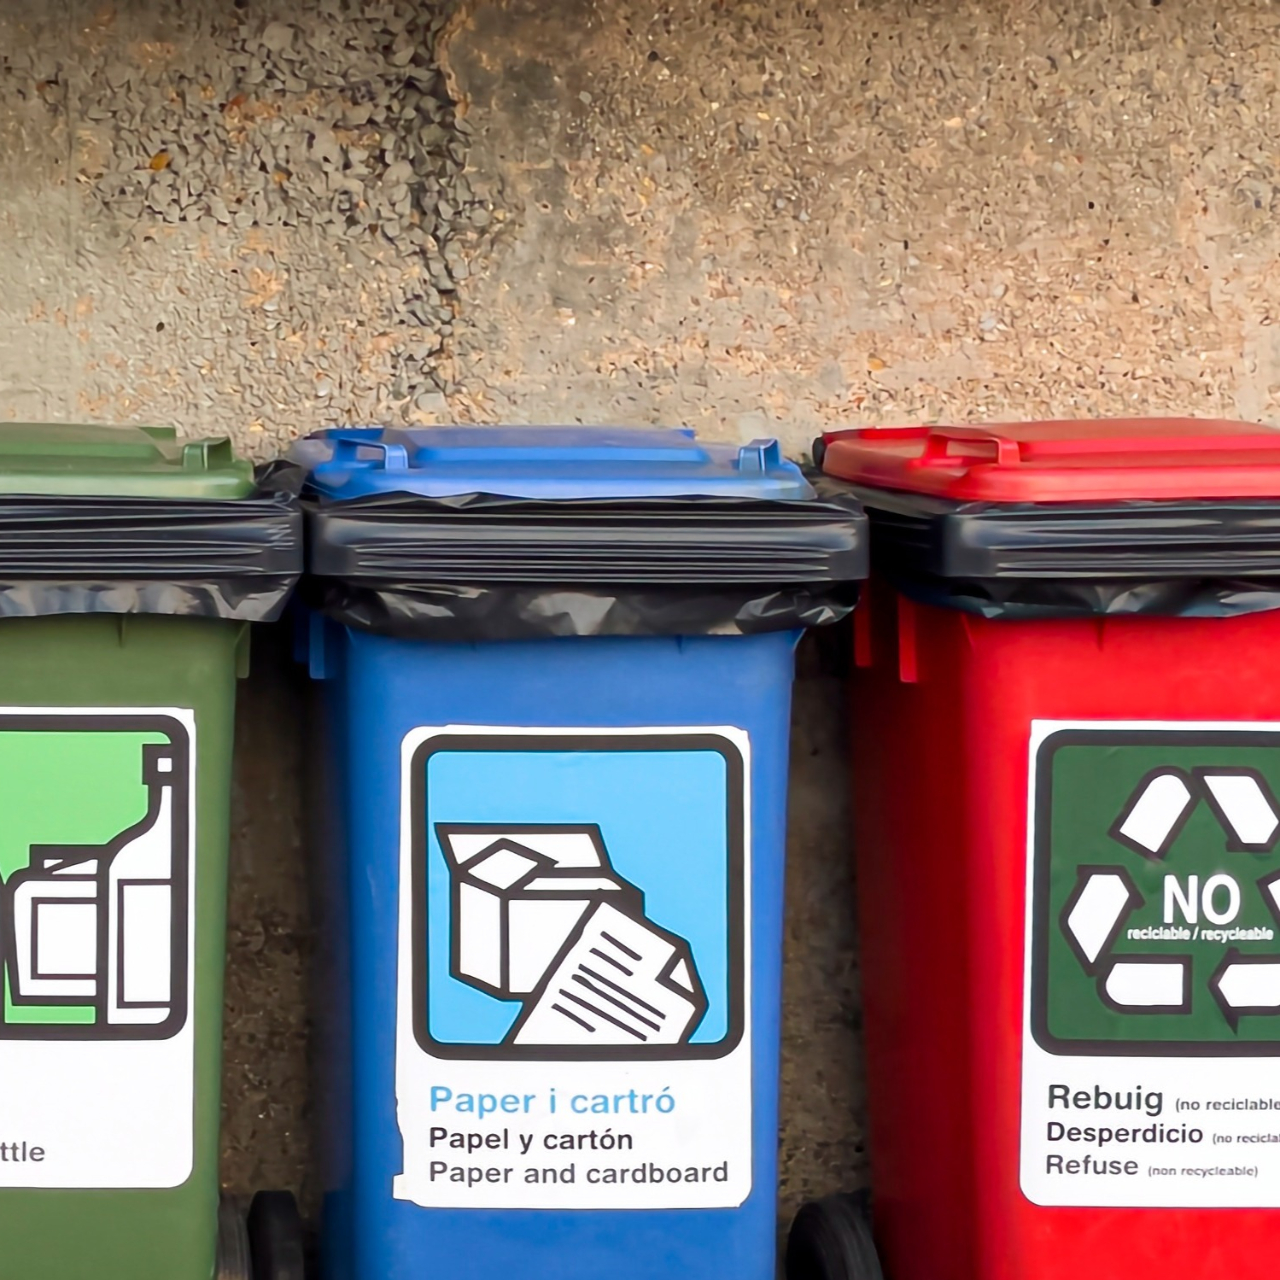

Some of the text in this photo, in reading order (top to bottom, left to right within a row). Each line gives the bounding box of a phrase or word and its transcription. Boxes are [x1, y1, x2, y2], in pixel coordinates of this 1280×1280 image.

[1163, 873, 1241, 926] NO
[1127, 926, 1191, 940] reciclable
[430, 1085, 676, 1120] Paper i cartró
[1048, 1084, 1163, 1117] Rebuig
[1175, 1097, 1201, 1113] (no
[429, 1126, 634, 1156] Papel y cartón
[1046, 1121, 1204, 1148] Desperdicio
[1212, 1133, 1233, 1145] (no
[429, 1160, 729, 1189] Paper and cardboard
[1046, 1154, 1139, 1176] Refuse
[1148, 1166, 1177, 1177] (non
